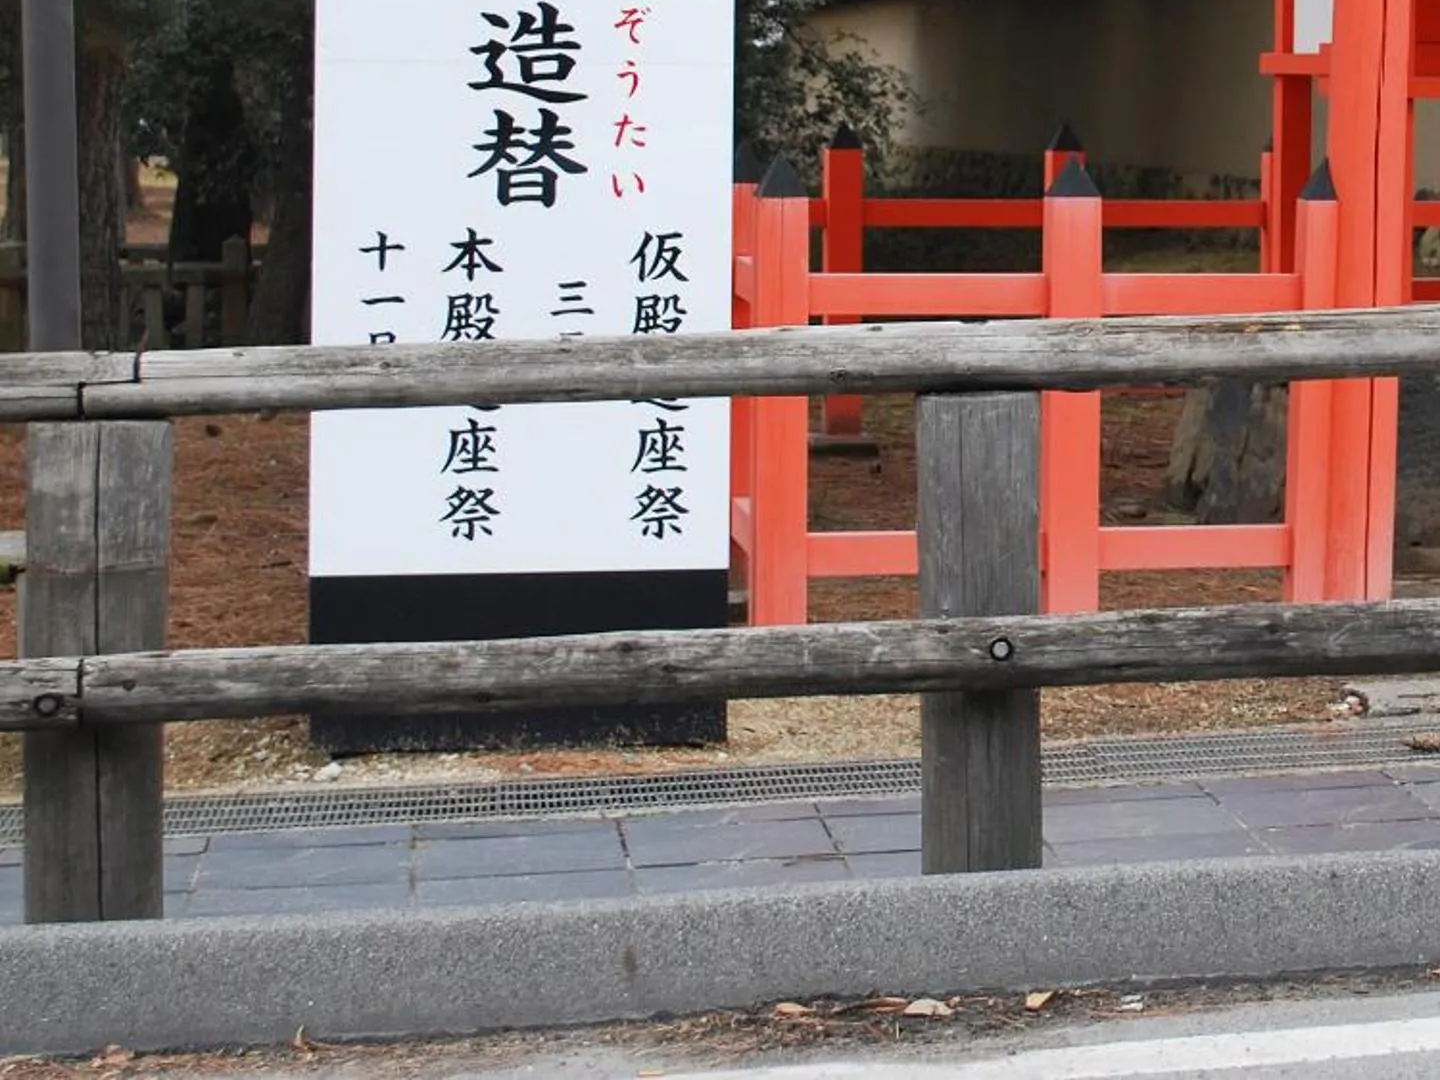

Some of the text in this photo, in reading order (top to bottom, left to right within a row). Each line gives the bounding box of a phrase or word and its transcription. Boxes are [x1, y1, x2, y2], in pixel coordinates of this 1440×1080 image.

[439, 227, 504, 541] 本殿座祭
[551, 281, 594, 339] 三
[630, 231, 689, 541] 仮殿座祭
